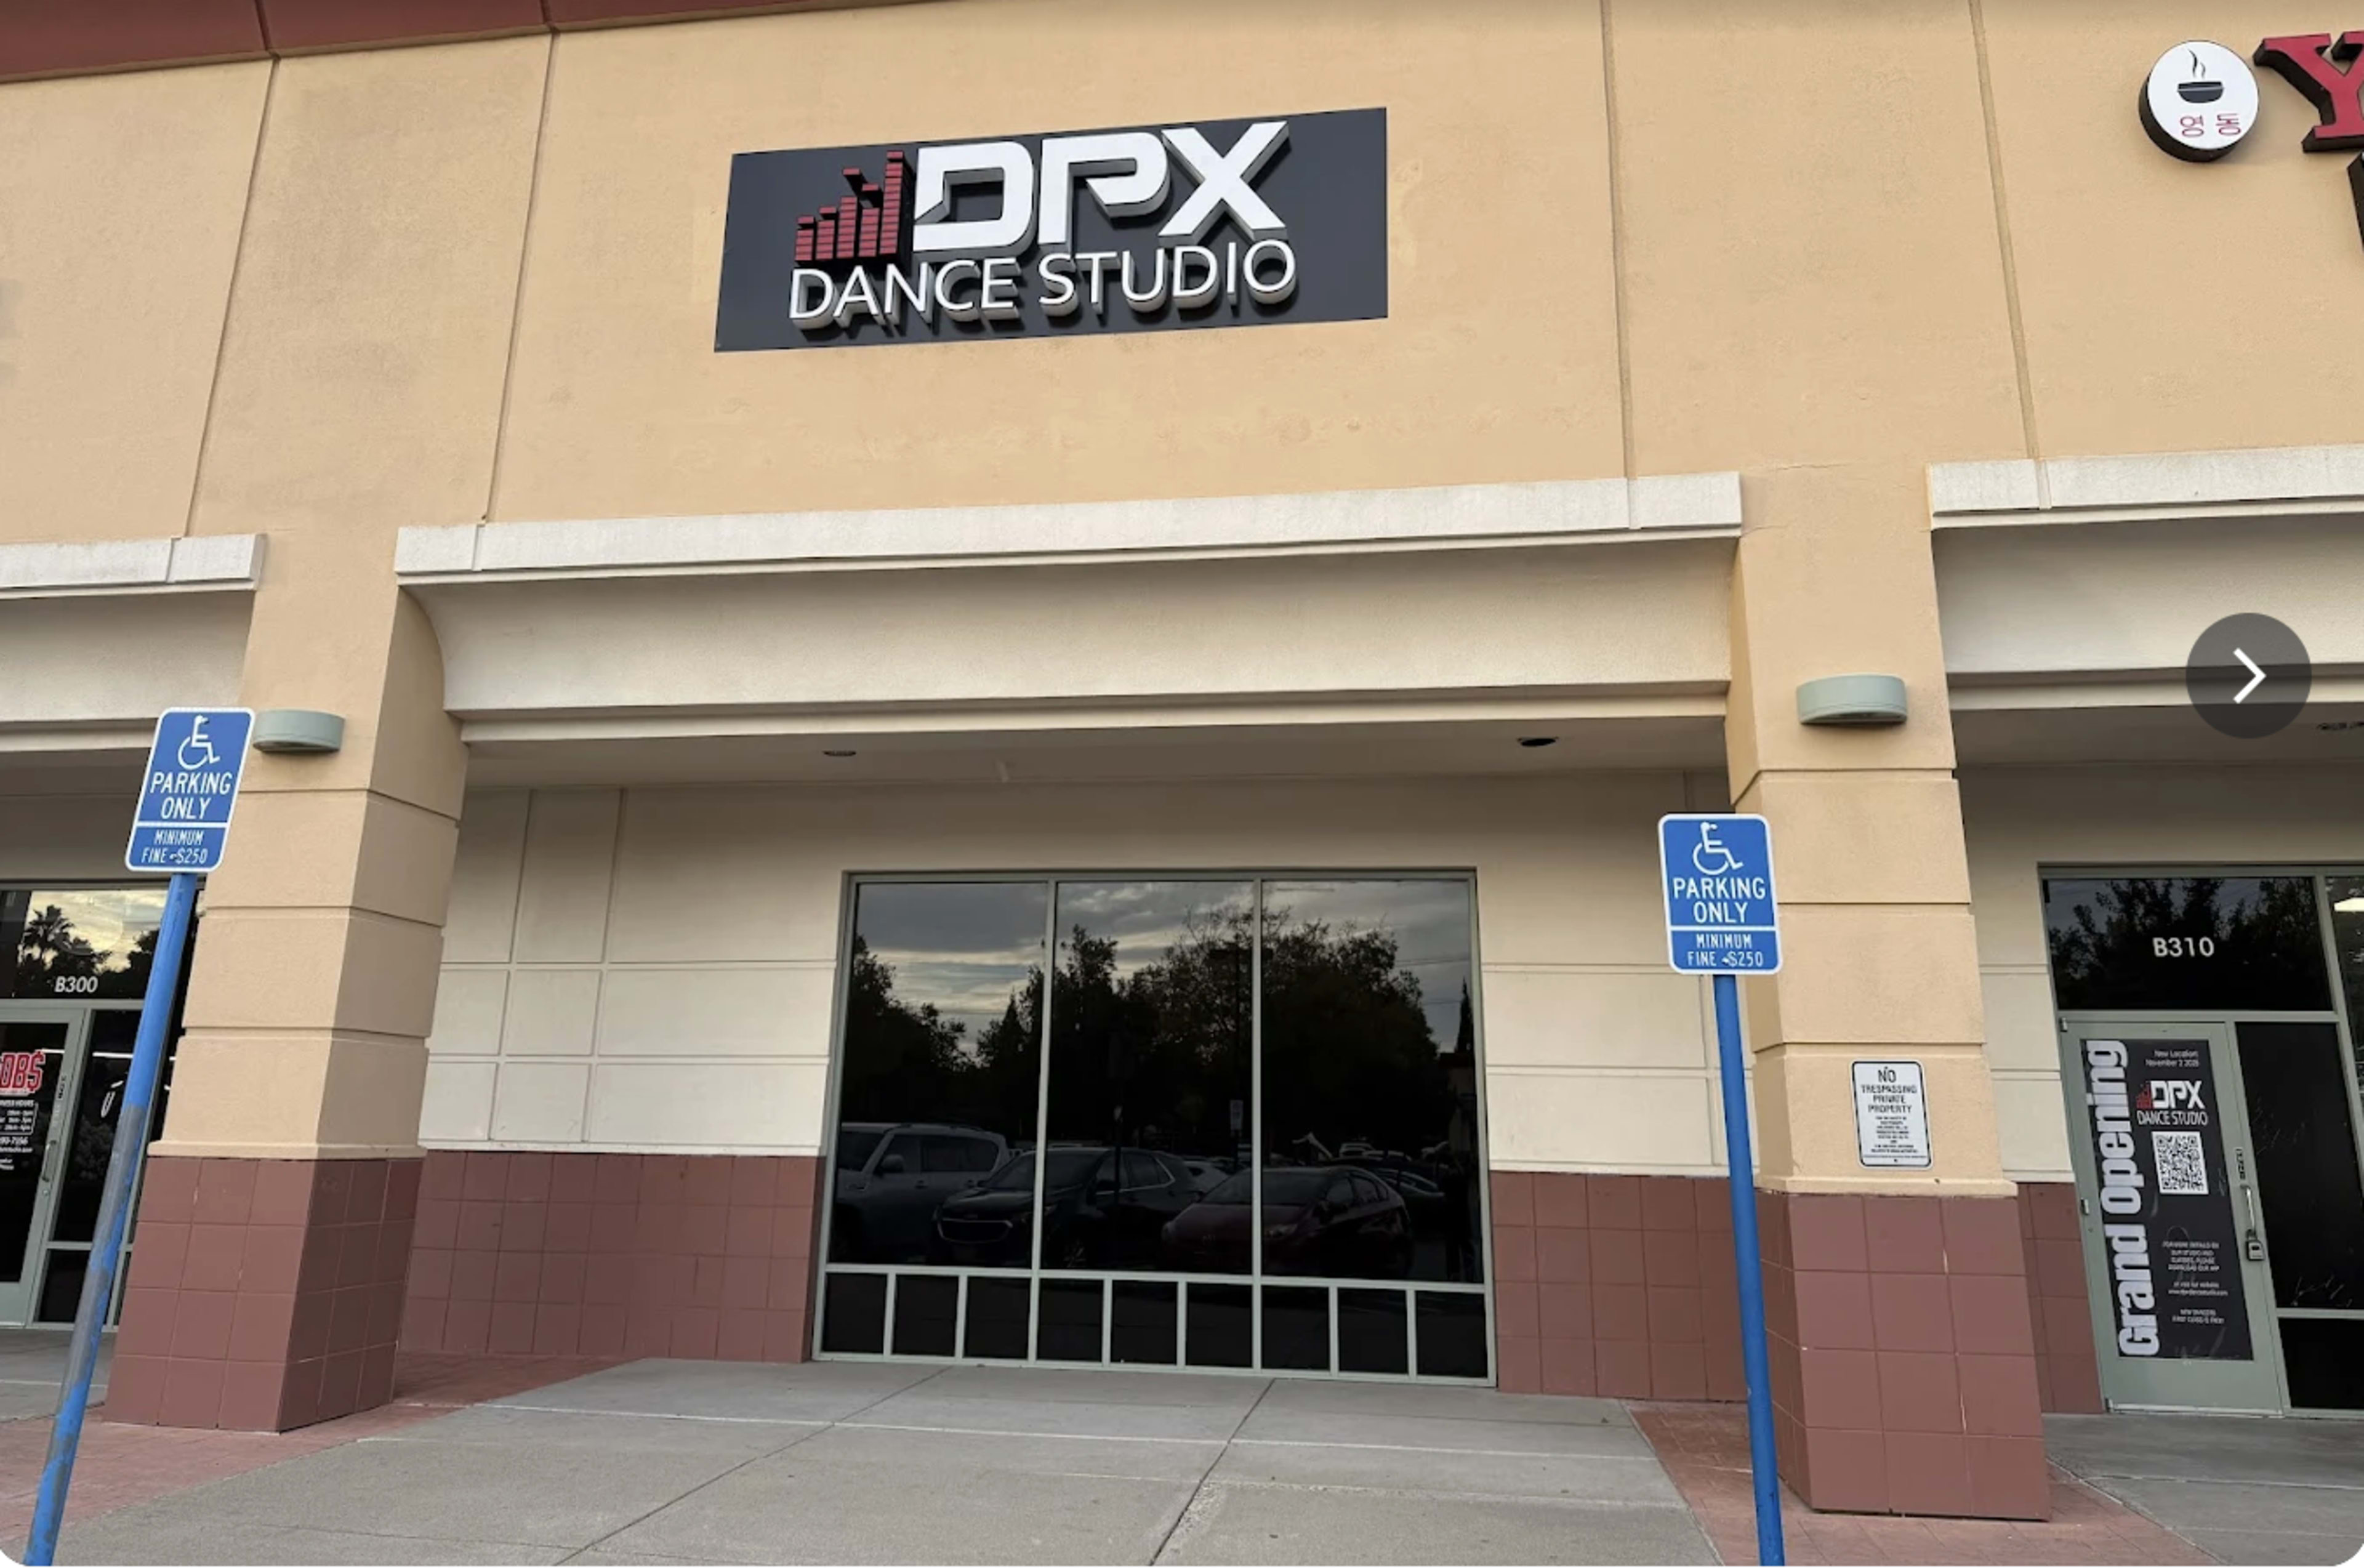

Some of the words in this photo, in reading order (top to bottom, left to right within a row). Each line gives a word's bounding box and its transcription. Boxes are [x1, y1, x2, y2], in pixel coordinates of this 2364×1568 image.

[913, 121, 1290, 251] DPX
[789, 257, 1021, 320] DANCE
[1038, 239, 1295, 308] STUDIO
[150, 771, 233, 795] PARKING
[160, 797, 211, 820] ONLY
[153, 829, 204, 846] MINIMUM
[141, 847, 169, 864] FINE
[1673, 877, 1766, 899] PARKING
[1694, 901, 1748, 923] ONLY
[1696, 933, 1752, 949] MINIMUM
[2153, 936, 2214, 957] B310
[1687, 951, 1716, 967] FINE
[54, 976, 98, 993] B300
[1878, 1069, 1897, 1083] NO
[1861, 1085, 1917, 1093] TRESPASSING
[2150, 1080, 2205, 1109] DPX
[1873, 1095, 1906, 1103] PRIVATE
[1868, 1105, 1912, 1113] PROPERTY
[2137, 1110, 2170, 1125] DANCE
[2171, 1111, 2208, 1126] STUDIO
[2086, 1040, 2145, 1215] Opening
[2104, 1224, 2160, 1356] Grand
